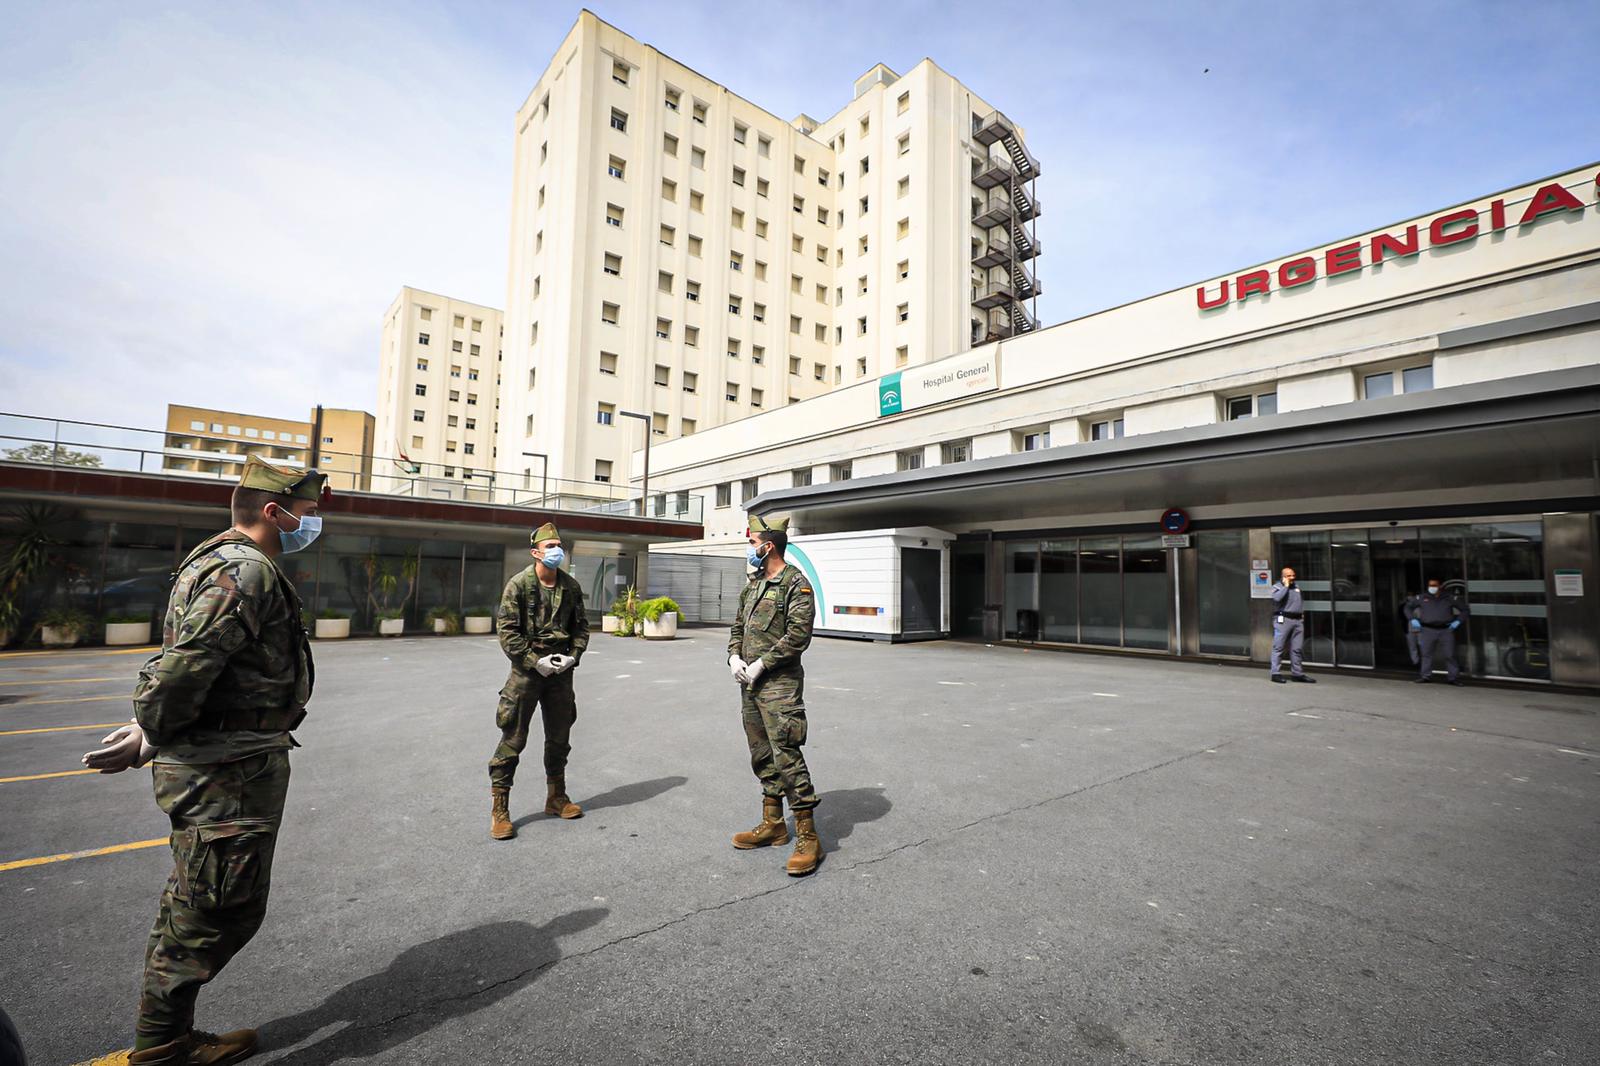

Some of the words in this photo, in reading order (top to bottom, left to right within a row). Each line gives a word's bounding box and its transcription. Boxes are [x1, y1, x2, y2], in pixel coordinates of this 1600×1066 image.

[1197, 172, 1600, 310] URGENCIA
[923, 373, 954, 389] Hospital
[956, 363, 989, 380] General
